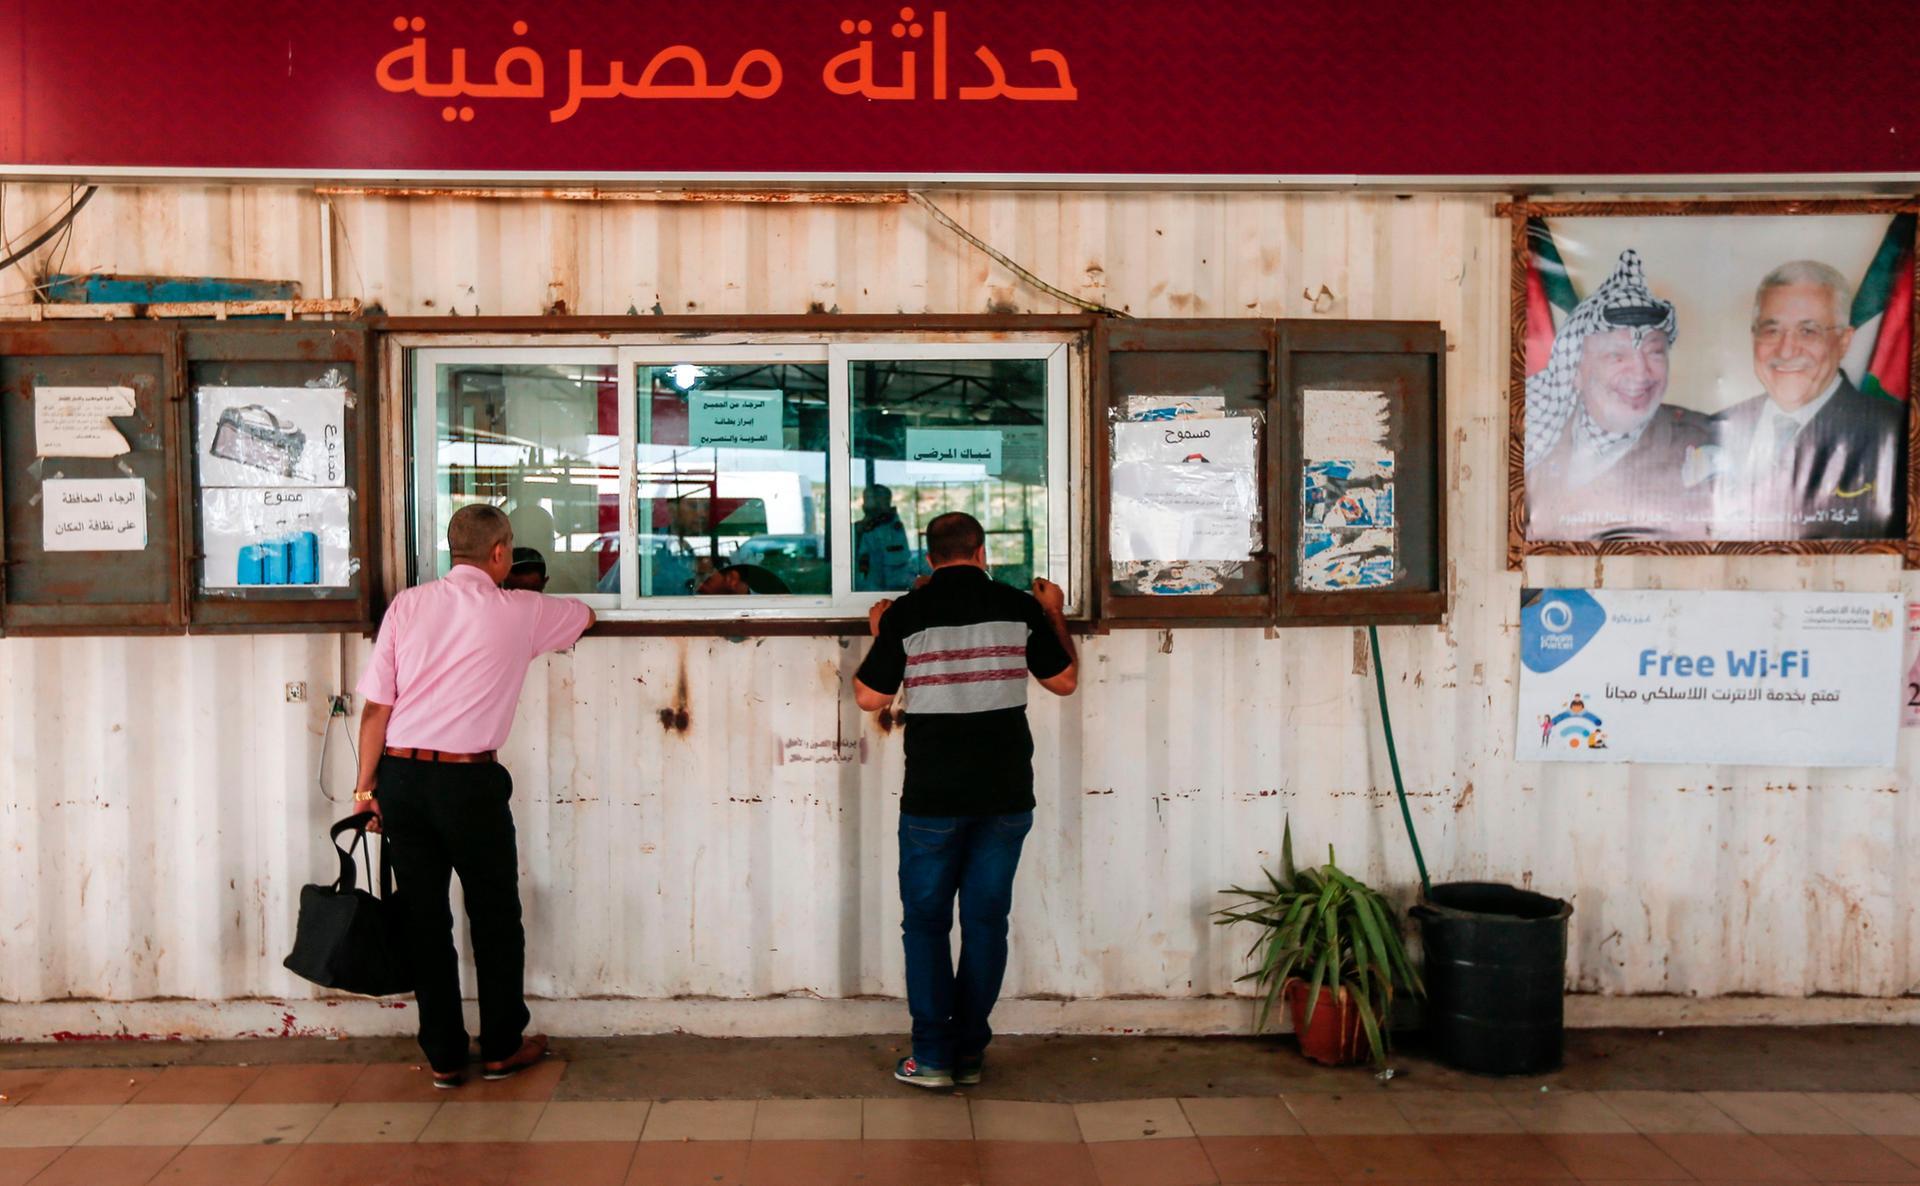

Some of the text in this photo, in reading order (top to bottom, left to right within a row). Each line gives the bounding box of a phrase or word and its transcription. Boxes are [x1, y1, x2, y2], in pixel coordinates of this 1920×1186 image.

[374, 6, 1079, 124] حداثة مصرفية
[703, 400, 766, 411] الرجاء من الجميع
[1164, 427, 1211, 444] مسموح
[913, 447, 992, 461] شباك المرضى
[61, 491, 136, 505] الرجاء المحافظة
[263, 490, 304, 506] ممنوع
[1830, 507, 1859, 526] شركة
[54, 518, 136, 536] على نظافة المكان
[1638, 647, 1810, 678] Free Wi-Fi
[1641, 685, 1708, 705] اللاسلكي
[1711, 687, 1763, 704] الانترنت
[1765, 687, 1806, 704] بخدمة
[1810, 687, 1841, 705] تمتع
